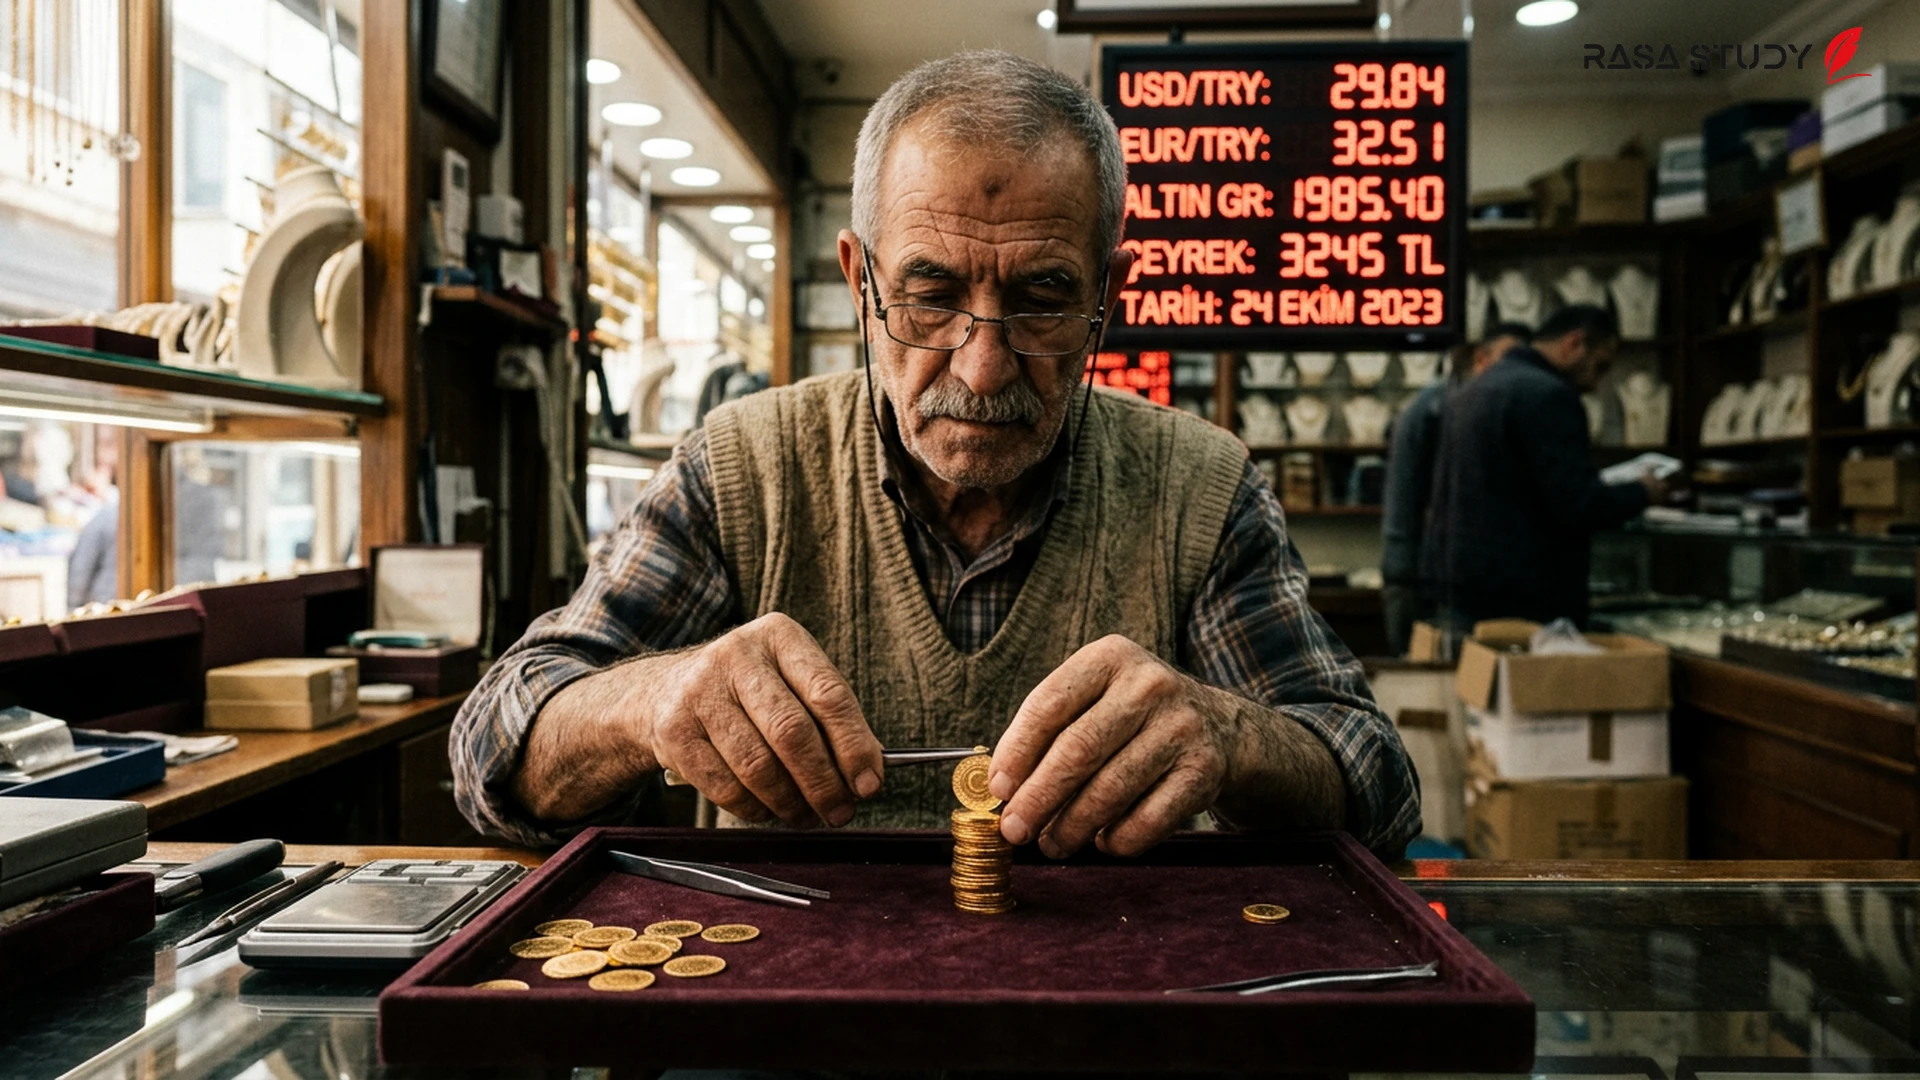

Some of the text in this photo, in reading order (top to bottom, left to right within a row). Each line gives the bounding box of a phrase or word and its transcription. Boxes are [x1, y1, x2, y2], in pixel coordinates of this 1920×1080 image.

[1119, 63, 1445, 109] USD/TRY: 29.84
[1121, 126, 1271, 162] EUR/TRY:
[1125, 175, 1444, 222] ALTIN GR: 1985.40
[1121, 232, 1445, 284] ÇEYREK: 3245 TL
[1119, 284, 1443, 326] TARİH: 24 EKİM 2023
